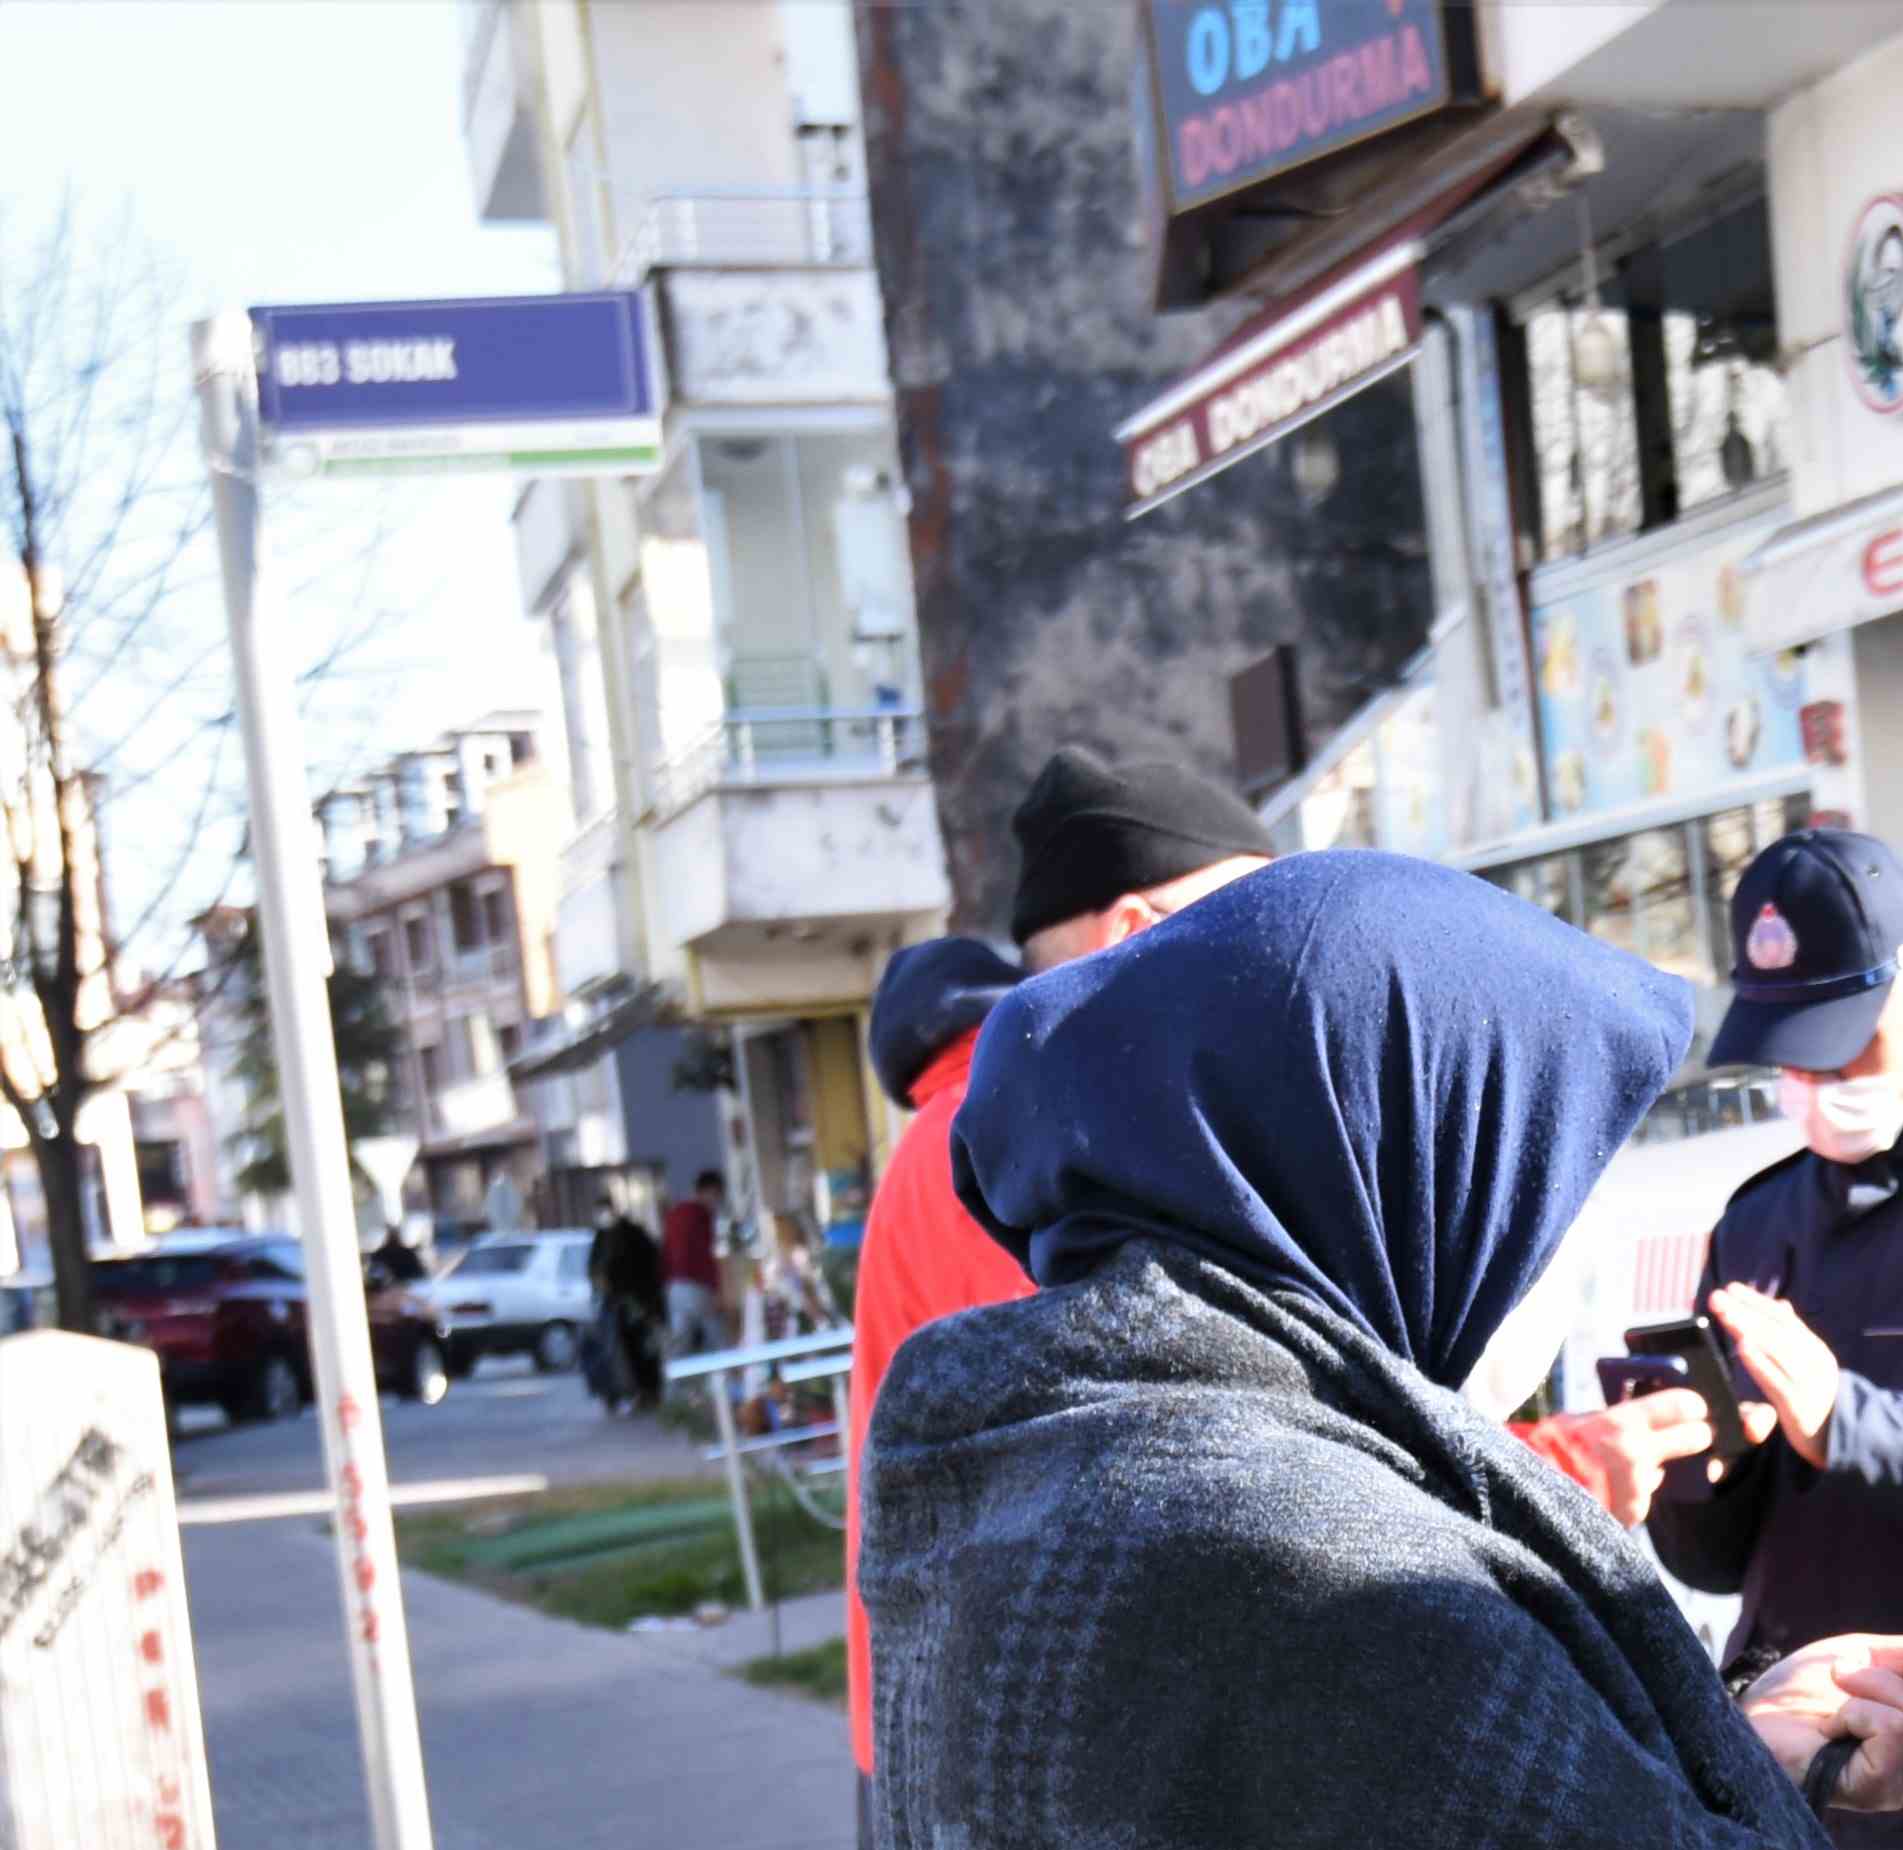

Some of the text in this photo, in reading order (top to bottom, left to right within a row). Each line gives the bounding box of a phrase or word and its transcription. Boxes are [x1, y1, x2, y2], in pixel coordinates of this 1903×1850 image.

[1178, 24, 1431, 187] DONDURMA
[1186, 0, 1320, 95] OBA
[345, 336, 458, 383] SOKAK
[1209, 294, 1409, 457] DONDURMA
